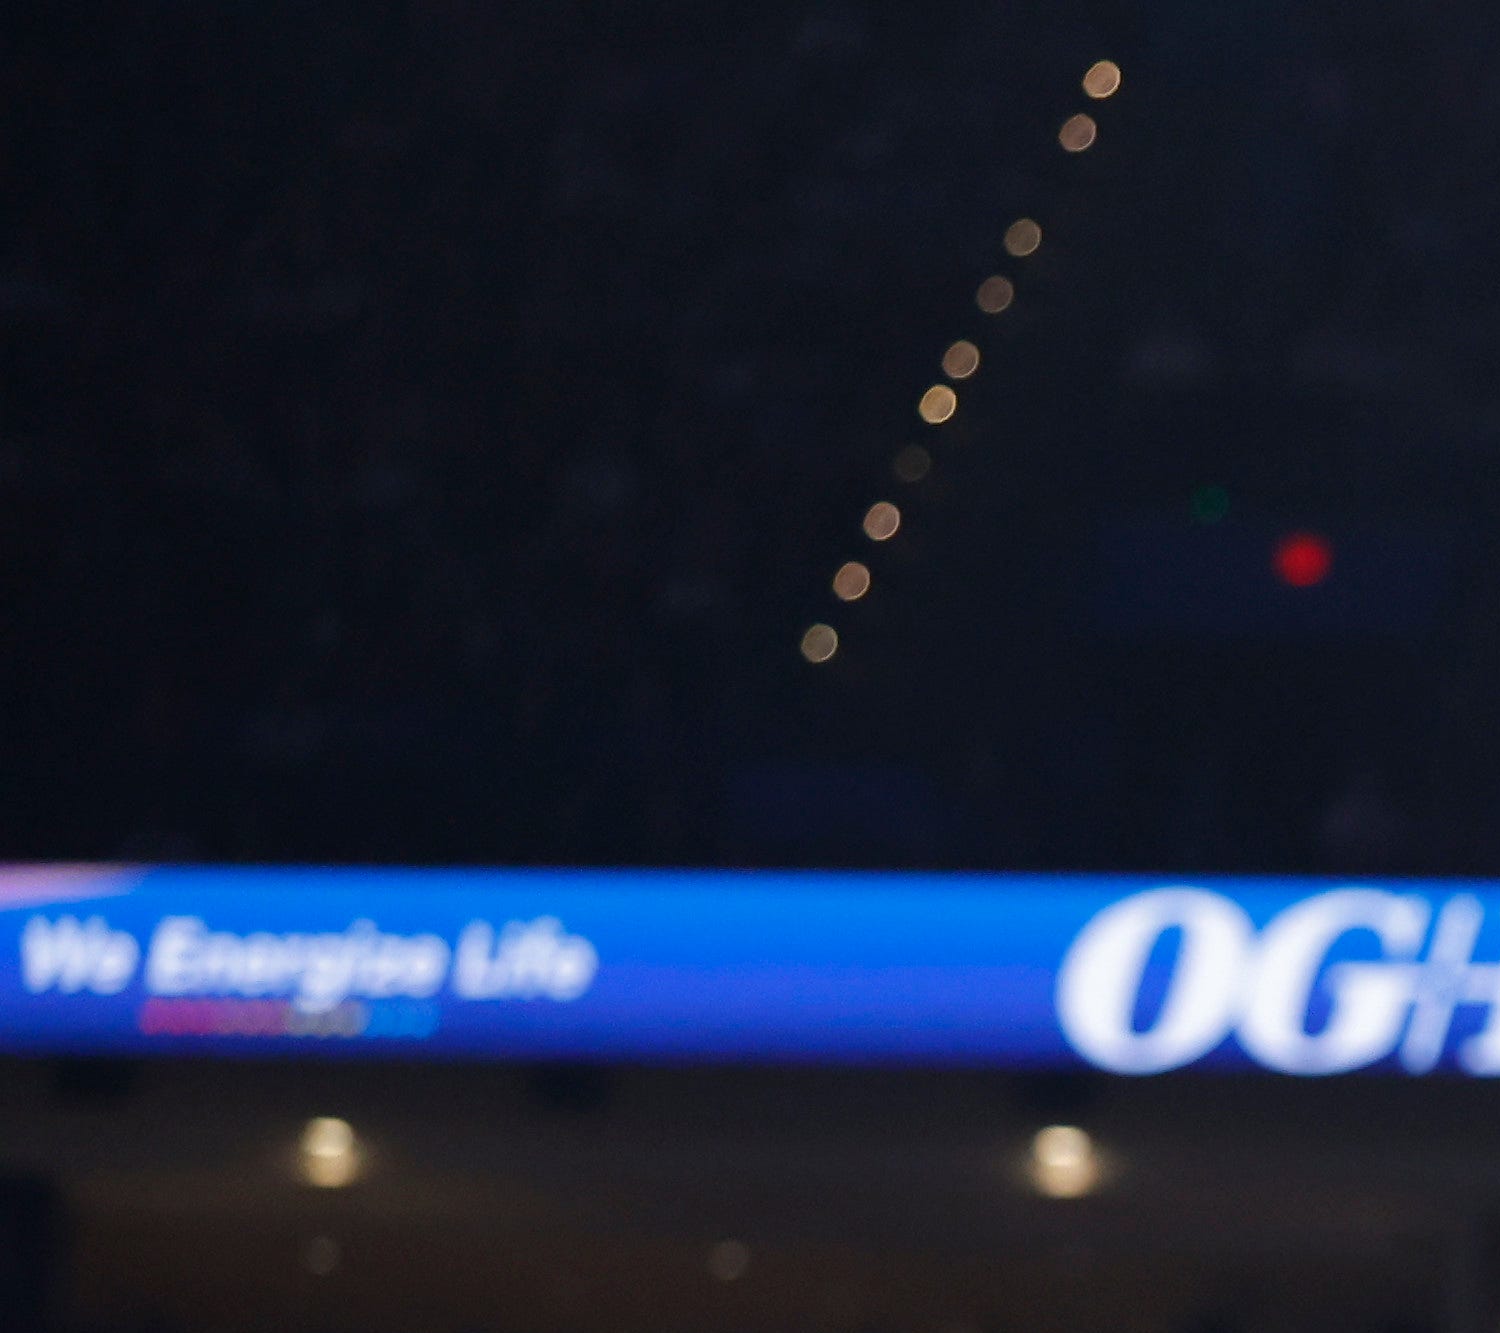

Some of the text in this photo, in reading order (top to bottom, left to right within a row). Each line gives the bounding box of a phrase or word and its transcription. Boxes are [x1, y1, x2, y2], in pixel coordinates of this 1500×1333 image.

[21, 917, 598, 1014] We Energize Life
